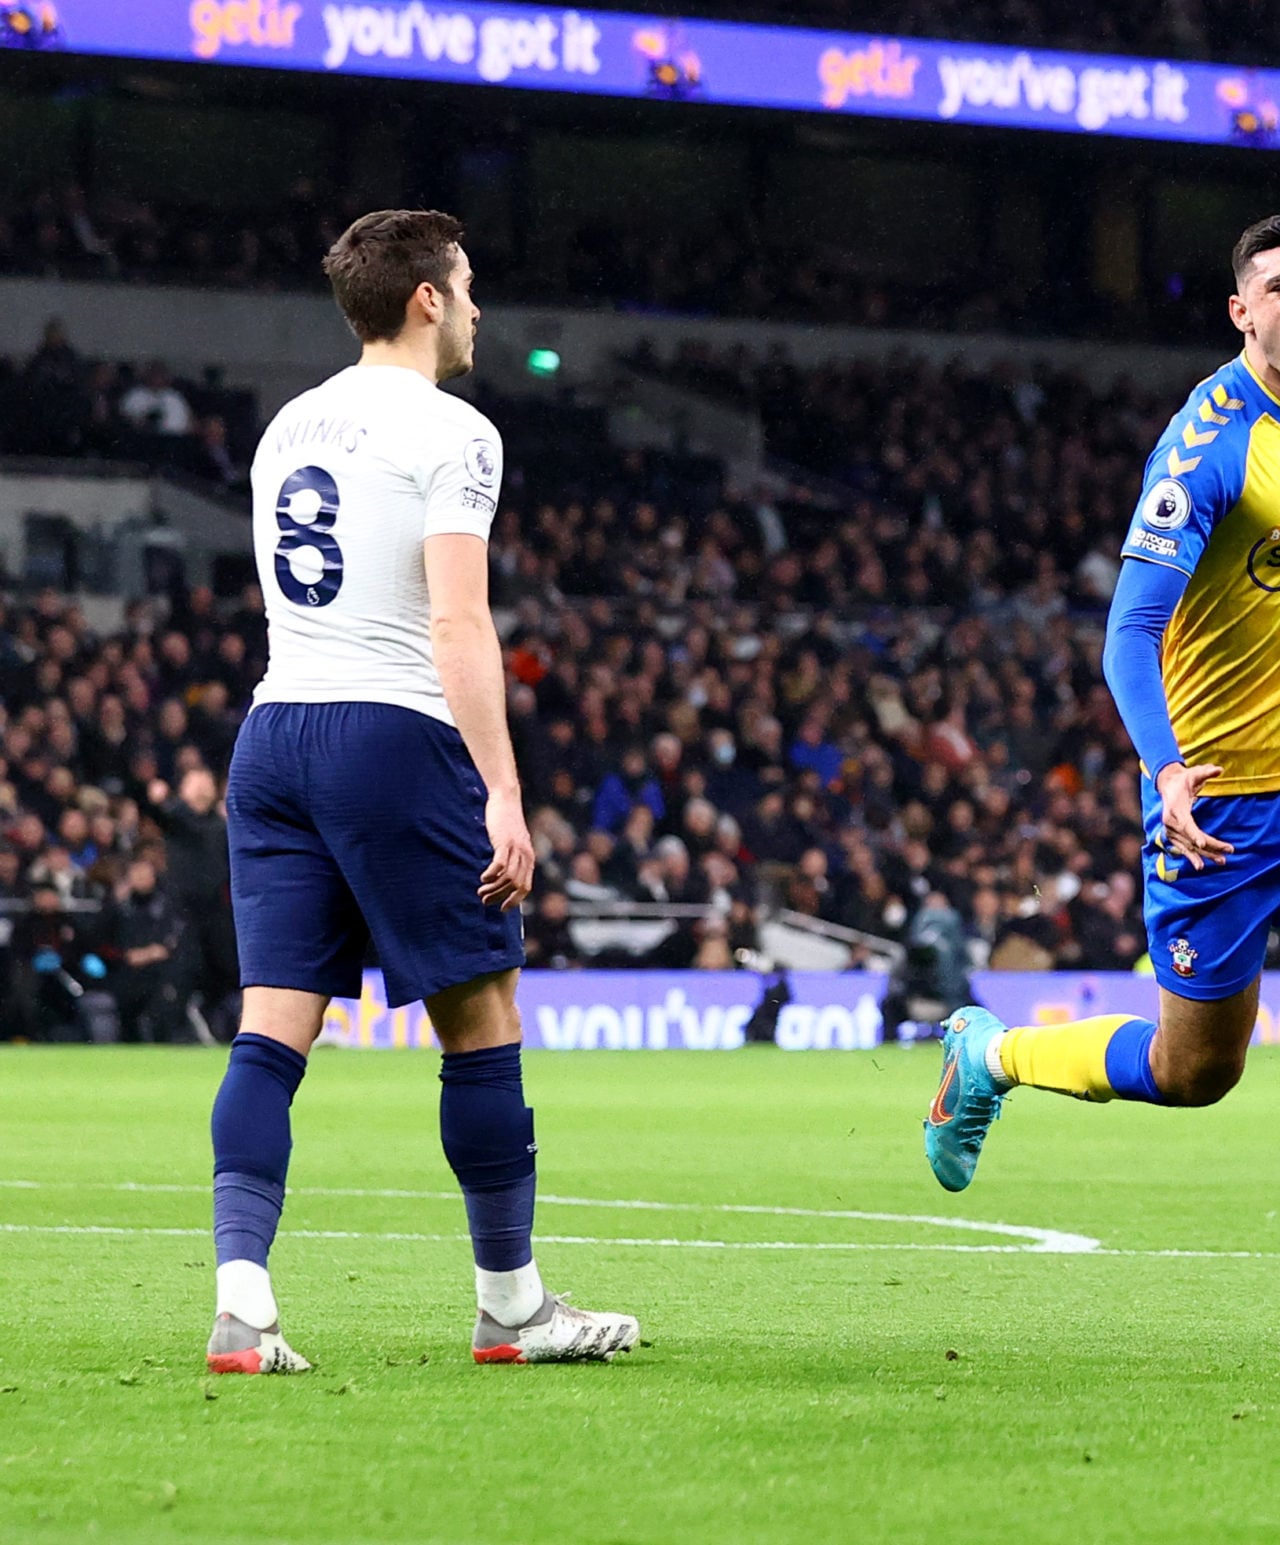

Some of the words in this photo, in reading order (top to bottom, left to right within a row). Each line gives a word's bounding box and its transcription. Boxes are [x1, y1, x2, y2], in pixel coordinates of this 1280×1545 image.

[322, 2, 475, 69] you've
[478, 15, 557, 82] got
[562, 11, 599, 75] it
[937, 53, 1074, 117] you've
[1077, 66, 1150, 130] got
[1152, 62, 1188, 123] it
[276, 418, 367, 454] WINKS
[275, 465, 344, 608] 8
[1146, 532, 1176, 549] room
